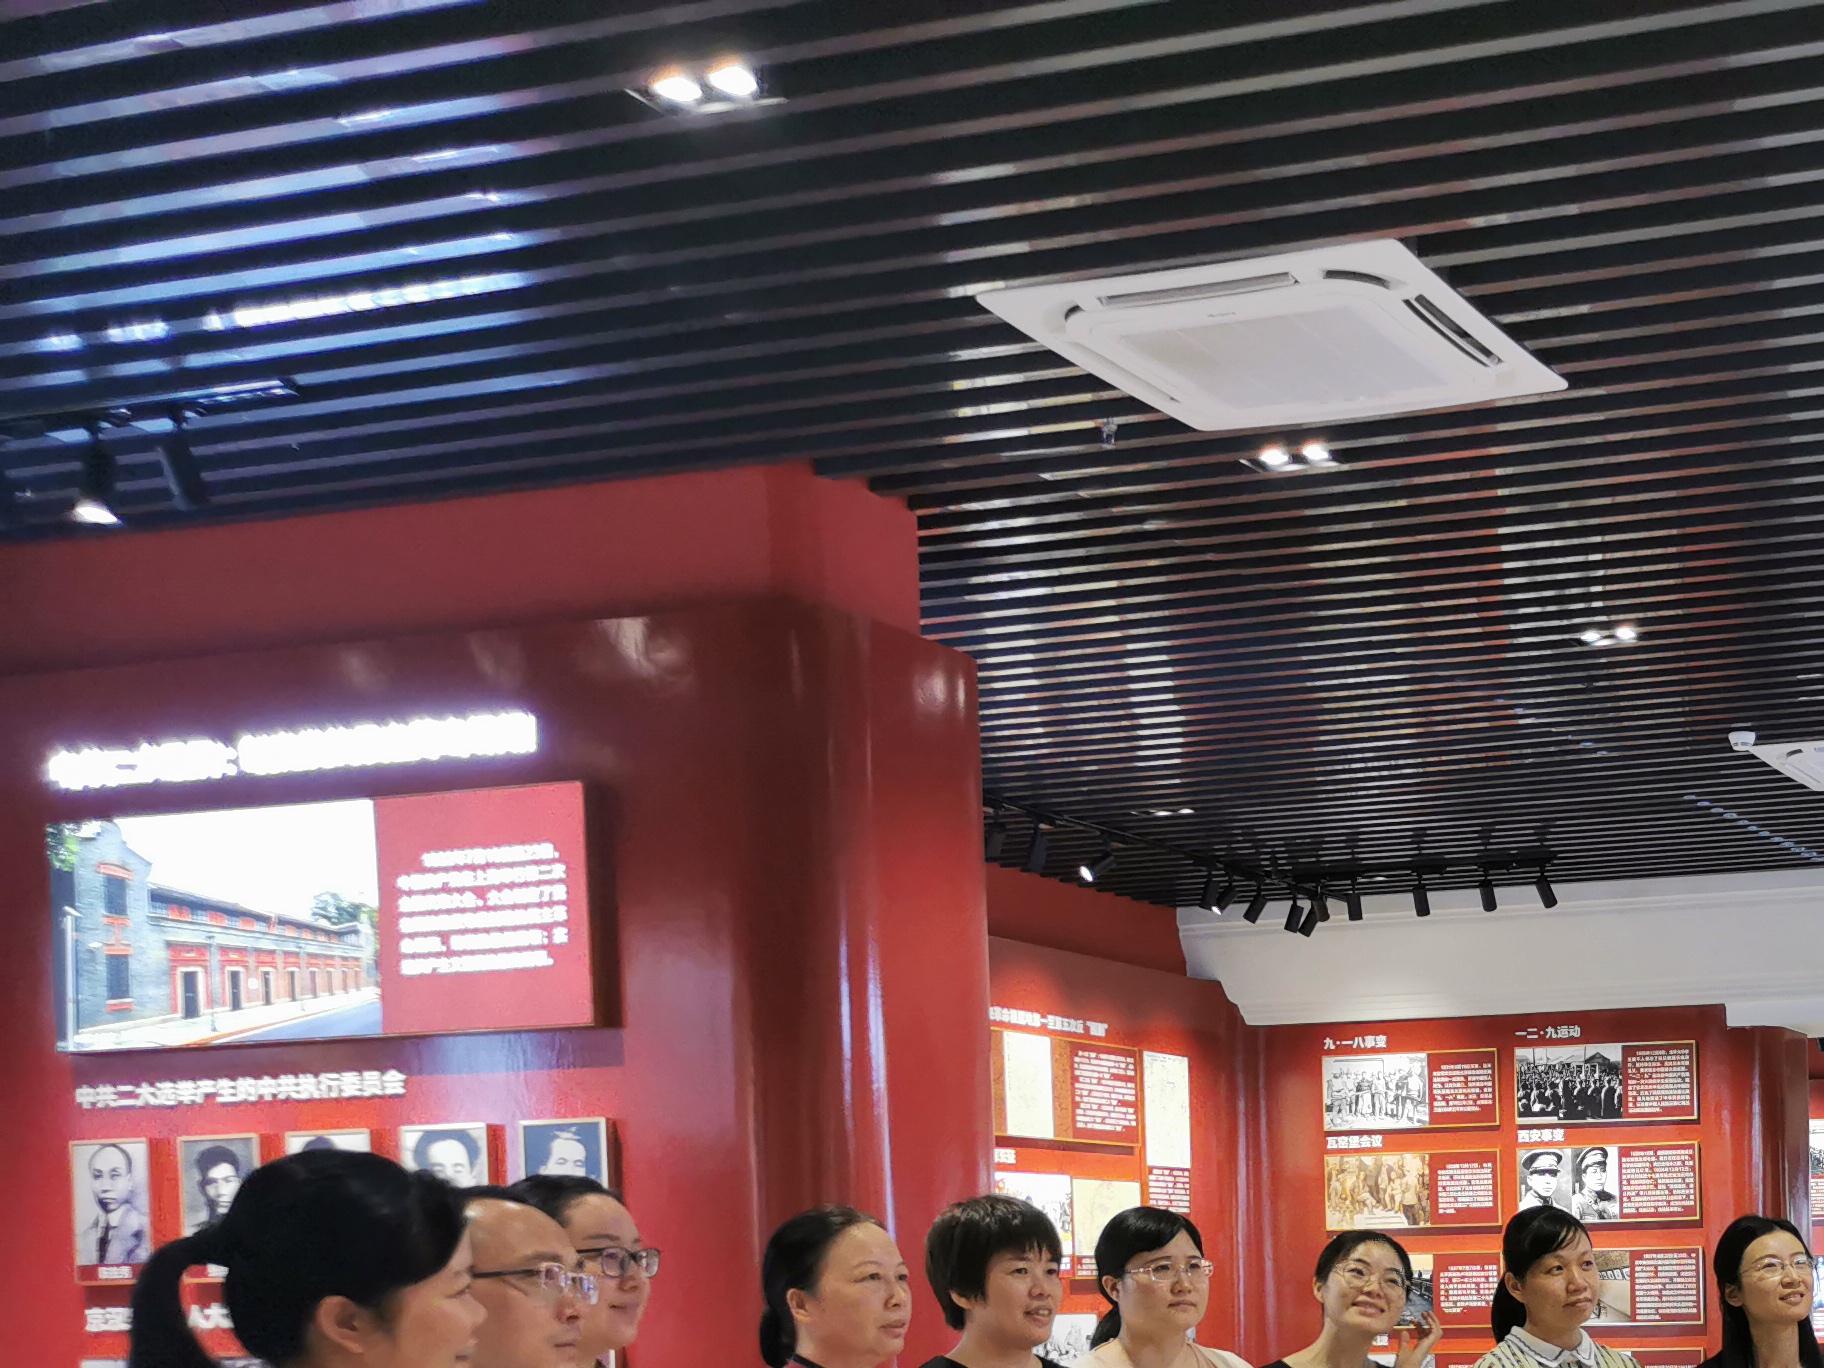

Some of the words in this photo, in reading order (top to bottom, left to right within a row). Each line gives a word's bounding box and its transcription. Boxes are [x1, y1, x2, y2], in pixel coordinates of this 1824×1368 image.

[1515, 1025, 1581, 1040] 一二·九运动
[1323, 1035, 1387, 1050] 九·一八事变
[1326, 1134, 1383, 1149] 瓦窑堡会议
[1517, 1128, 1565, 1143] 西安事变
